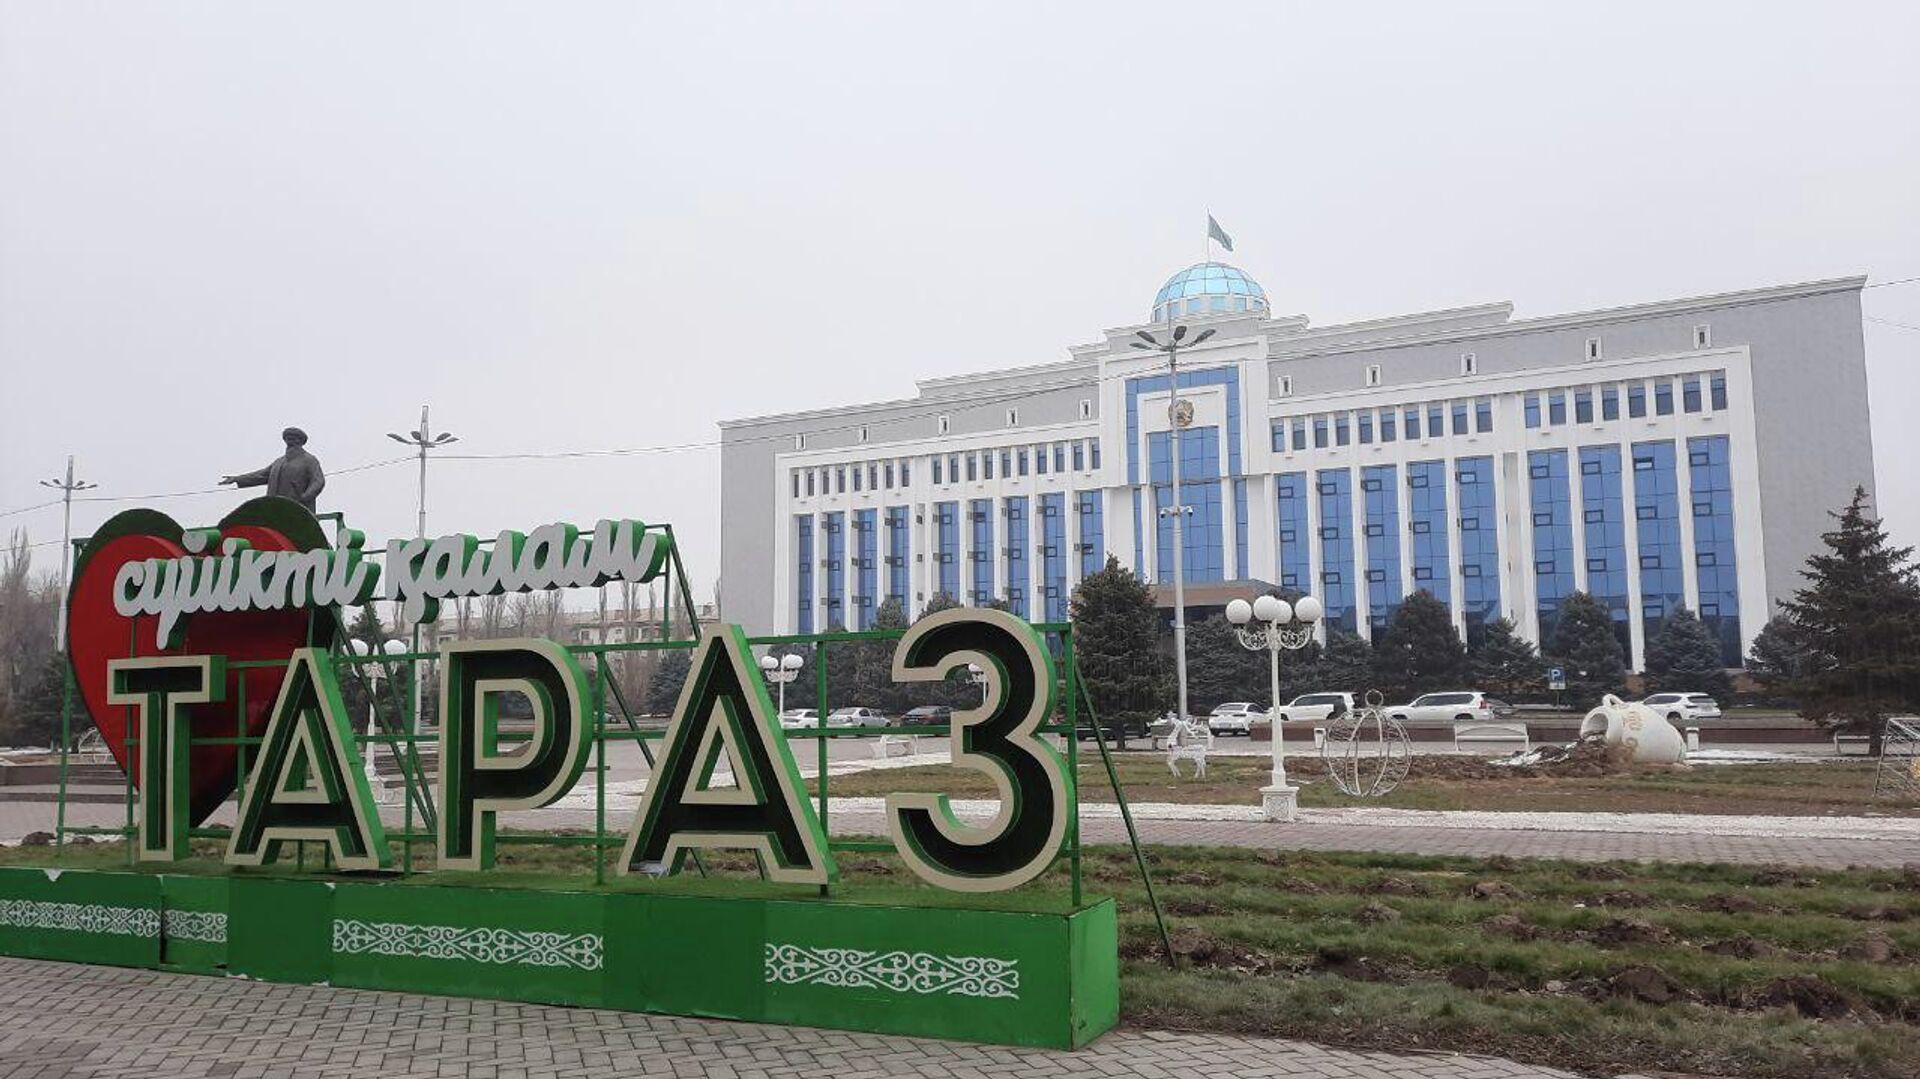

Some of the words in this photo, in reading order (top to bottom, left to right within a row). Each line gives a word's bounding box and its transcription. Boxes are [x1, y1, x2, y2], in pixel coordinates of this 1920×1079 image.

[113, 528, 370, 650] сүйікті
[384, 518, 660, 624] қалам
[107, 607, 1072, 893] ТАРАЗ
